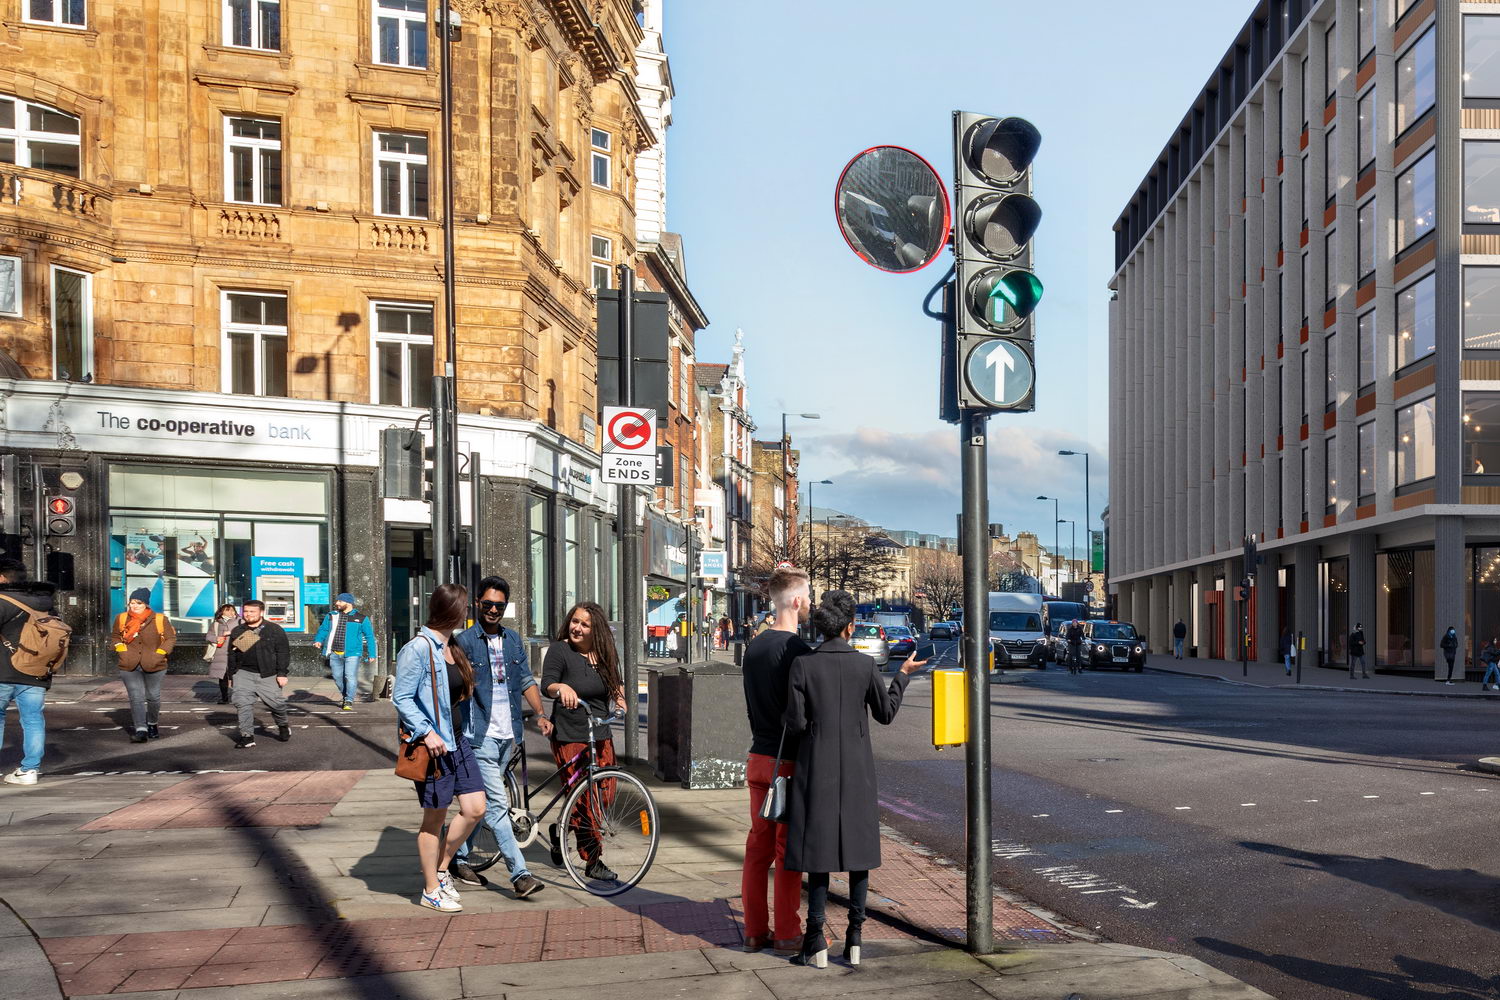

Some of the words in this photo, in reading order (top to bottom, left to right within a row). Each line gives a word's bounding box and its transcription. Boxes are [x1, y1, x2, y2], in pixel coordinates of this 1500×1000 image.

[97, 411, 130, 429] The
[136, 417, 255, 437] co-operative
[268, 422, 312, 440] bank
[615, 457, 642, 467] Zone
[608, 468, 650, 480] ENDS
